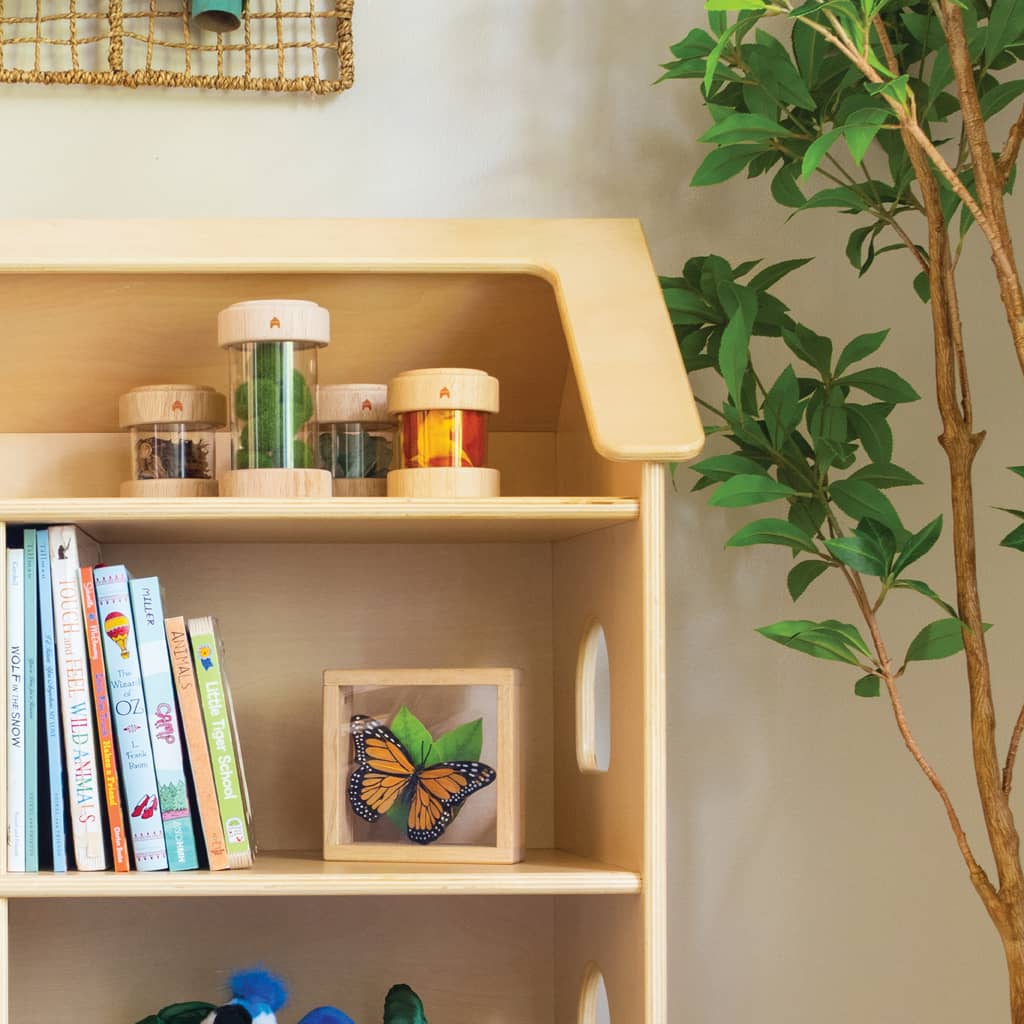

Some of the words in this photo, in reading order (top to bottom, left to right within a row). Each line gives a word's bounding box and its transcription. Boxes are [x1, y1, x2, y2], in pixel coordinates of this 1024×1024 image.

[59, 580, 80, 634] TOUCH
[142, 587, 155, 626] MILLER
[11, 645, 21, 683] WOLF
[63, 638, 73, 656] and
[171, 631, 193, 691] ANIMALS
[65, 659, 85, 698] FEEL
[117, 669, 131, 679] The
[115, 698, 145, 716] OZ
[205, 681, 221, 717] Little
[11, 712, 21, 749] SNOW
[71, 702, 89, 746] WILD
[154, 702, 175, 745] CAMP
[211, 719, 226, 751] Tiger
[73, 751, 96, 824] ANIMALS
[107, 776, 118, 807] Friend
[218, 754, 238, 800] School
